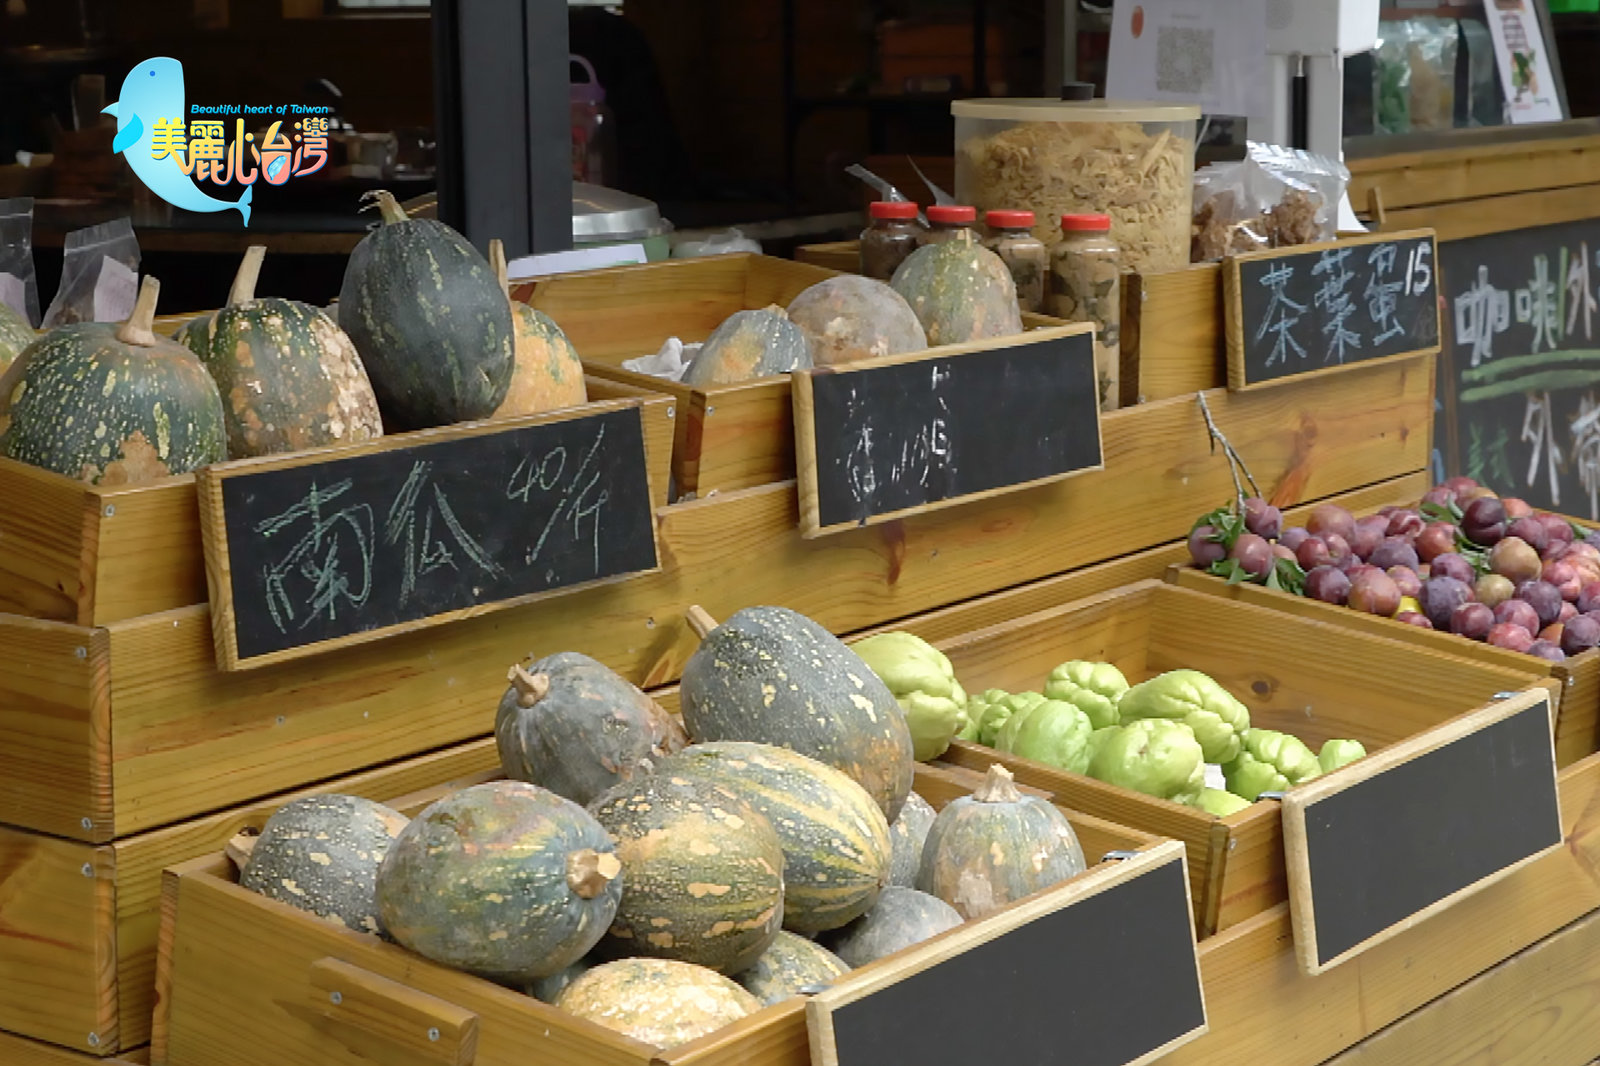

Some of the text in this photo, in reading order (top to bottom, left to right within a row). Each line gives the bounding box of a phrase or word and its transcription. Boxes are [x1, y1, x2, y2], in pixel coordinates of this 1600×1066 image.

[1255, 241, 1432, 367] 茶葉蛋 15
[254, 460, 506, 635] 南瓜
